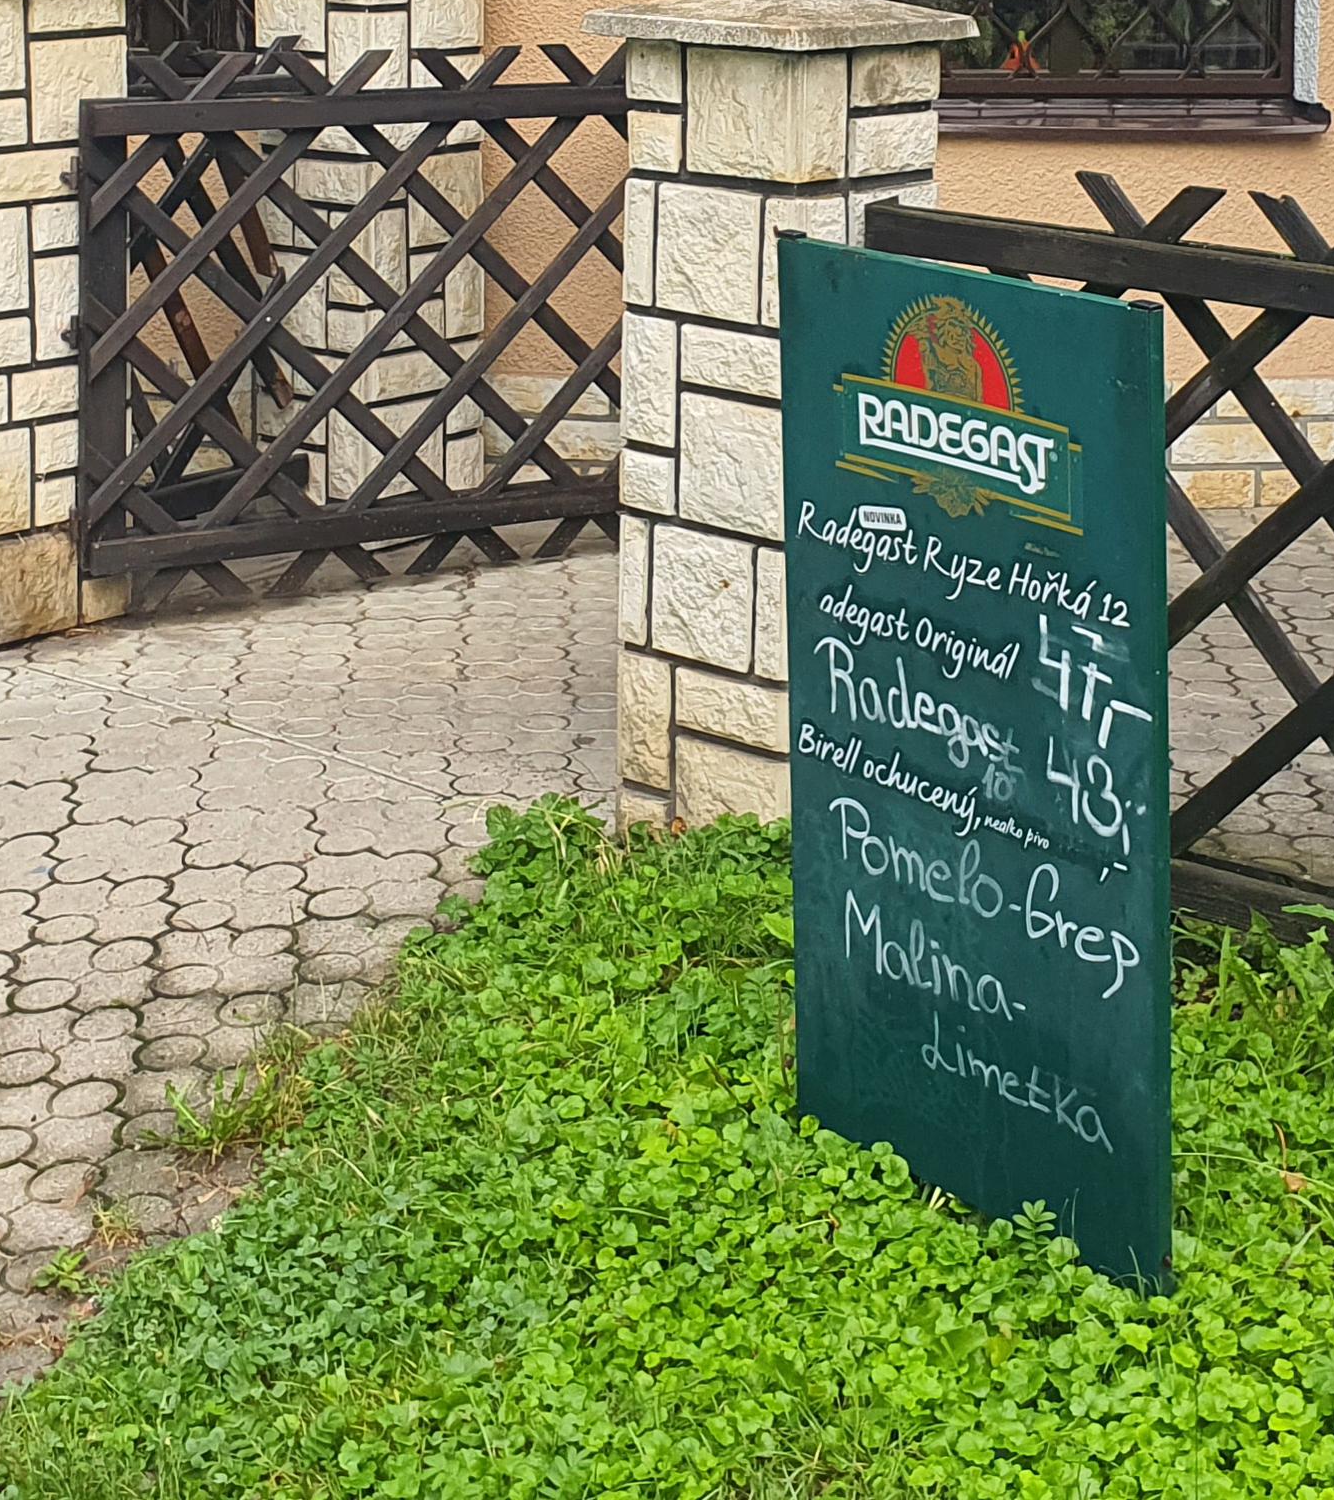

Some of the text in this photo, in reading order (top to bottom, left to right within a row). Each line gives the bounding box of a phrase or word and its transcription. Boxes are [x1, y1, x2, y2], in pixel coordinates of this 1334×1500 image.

[857, 391, 1056, 495] RADEGAST
[798, 500, 1131, 628] Radegast Ryze Hořká 12
[862, 510, 903, 526] NOVINKA
[813, 636, 1025, 769] Radegast
[915, 617, 1021, 681] Originál
[797, 723, 863, 774] Birell
[983, 814, 1023, 839] nealko
[1023, 827, 1050, 850] pivo
